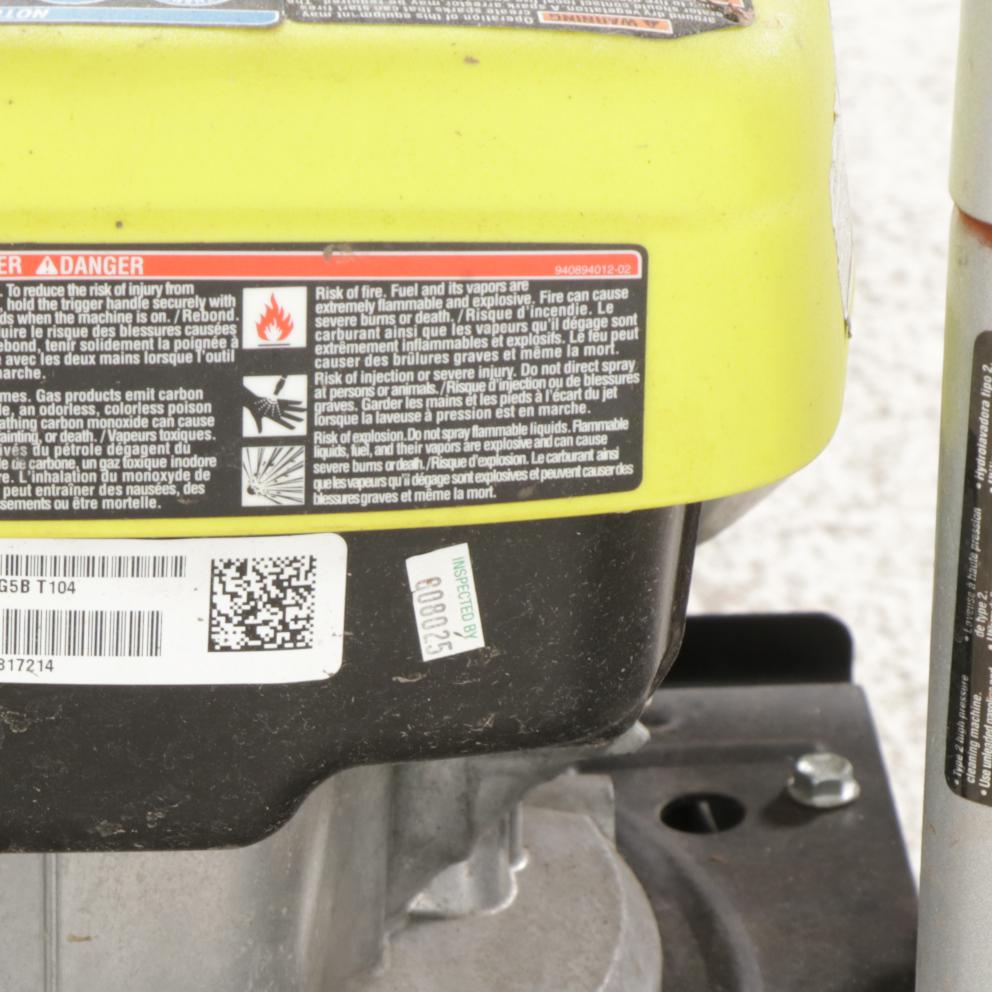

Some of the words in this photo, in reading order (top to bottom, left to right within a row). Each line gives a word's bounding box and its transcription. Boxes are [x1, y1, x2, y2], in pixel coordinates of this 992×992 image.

[60, 256, 144, 275] DANGER
[555, 264, 631, 276] 940894012-02
[6, 283, 21, 296] To
[24, 283, 64, 296] reduce
[67, 282, 86, 296] the
[90, 282, 112, 295] risk
[114, 282, 126, 295] of
[129, 281, 163, 299] injury
[165, 281, 194, 294] from
[315, 286, 343, 300] Risk
[346, 285, 358, 299] of
[361, 284, 386, 298] fire.
[391, 283, 418, 297] Fuel
[422, 281, 444, 295] and
[449, 280, 463, 294] its
[466, 281, 506, 297] vapors
[509, 280, 529, 291] are
[7, 297, 34, 310] hold
[38, 297, 57, 310] the
[61, 296, 103, 313] trigger
[106, 295, 149, 309] handle
[153, 295, 206, 312] securely
[209, 294, 236, 308] with
[315, 298, 375, 317] extremely
[378, 295, 442, 311] flammable
[446, 294, 469, 308] and
[473, 291, 535, 310] explosive.
[540, 289, 563, 303] Fire
[567, 290, 589, 302] can
[592, 289, 629, 300] cause
[314, 371, 342, 385] Risk
[346, 371, 357, 384] of
[361, 369, 414, 387] injection
[418, 371, 430, 381] or
[434, 369, 475, 381] severe
[478, 364, 516, 382] injury.
[521, 363, 538, 376] Do
[542, 361, 560, 375] not
[564, 359, 600, 374] direct
[602, 360, 635, 375] spray
[36, 388, 61, 401] Gas
[65, 388, 121, 405] products
[125, 387, 154, 400] emit
[159, 387, 203, 400] carbon
[981, 376, 992, 397] tipo
[19, 405, 35, 415] an
[39, 402, 100, 418] odorless,
[104, 401, 164, 414] colorless
[168, 401, 212, 417] poison
[40, 415, 83, 428] carbon
[87, 414, 148, 428] monoxide
[152, 417, 174, 427] can
[178, 416, 215, 427] cause
[974, 400, 990, 481] Hydrolavadora
[37, 580, 76, 594] T104
[452, 556, 474, 622] INSPECTED
[464, 624, 478, 640] BY
[976, 602, 988, 623] type
[975, 625, 985, 638] de
[969, 692, 982, 739] machine.
[954, 744, 964, 752] 2
[953, 754, 965, 776] Type
[966, 741, 980, 784] cleaning
[980, 770, 991, 788] Use
